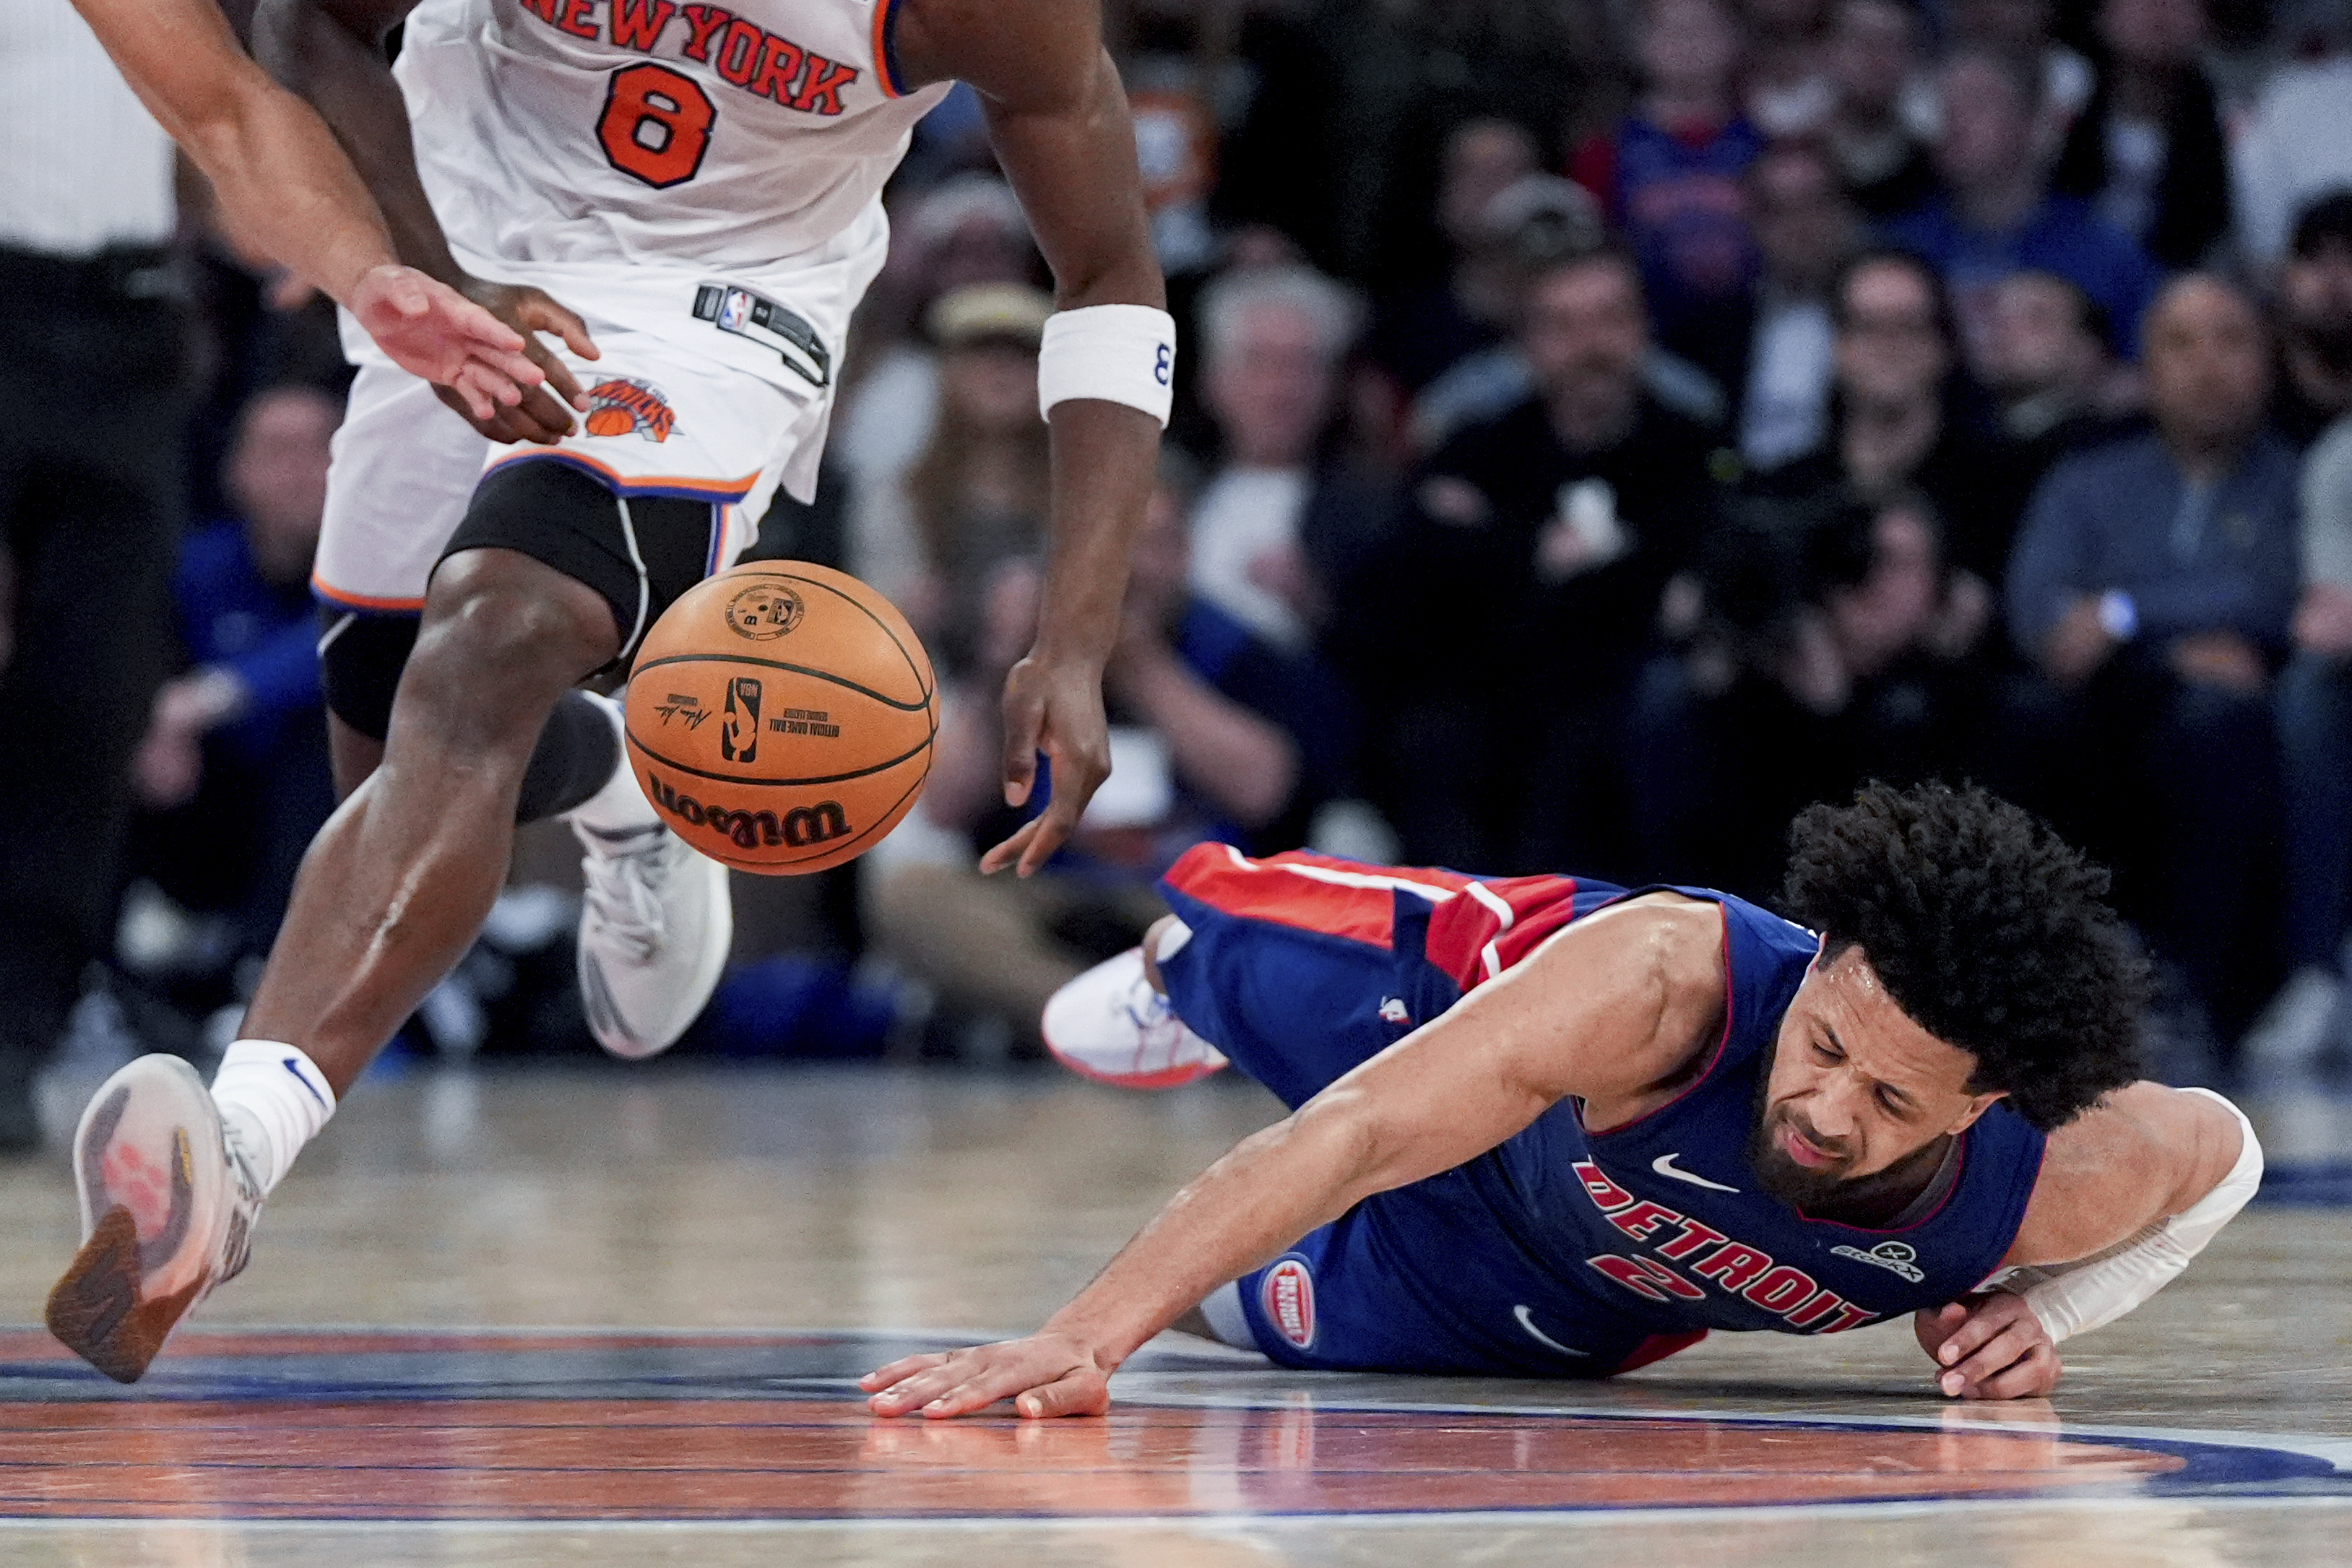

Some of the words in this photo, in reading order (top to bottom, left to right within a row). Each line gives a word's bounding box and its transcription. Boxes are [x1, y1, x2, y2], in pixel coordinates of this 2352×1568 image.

[680, 4, 860, 116] YORK
[595, 60, 717, 190] 8
[1154, 342, 1170, 386] 8
[649, 771, 852, 849] Wilson
[1571, 1154, 1882, 1333] DETROIT
[1586, 1254, 1707, 1301] 2
